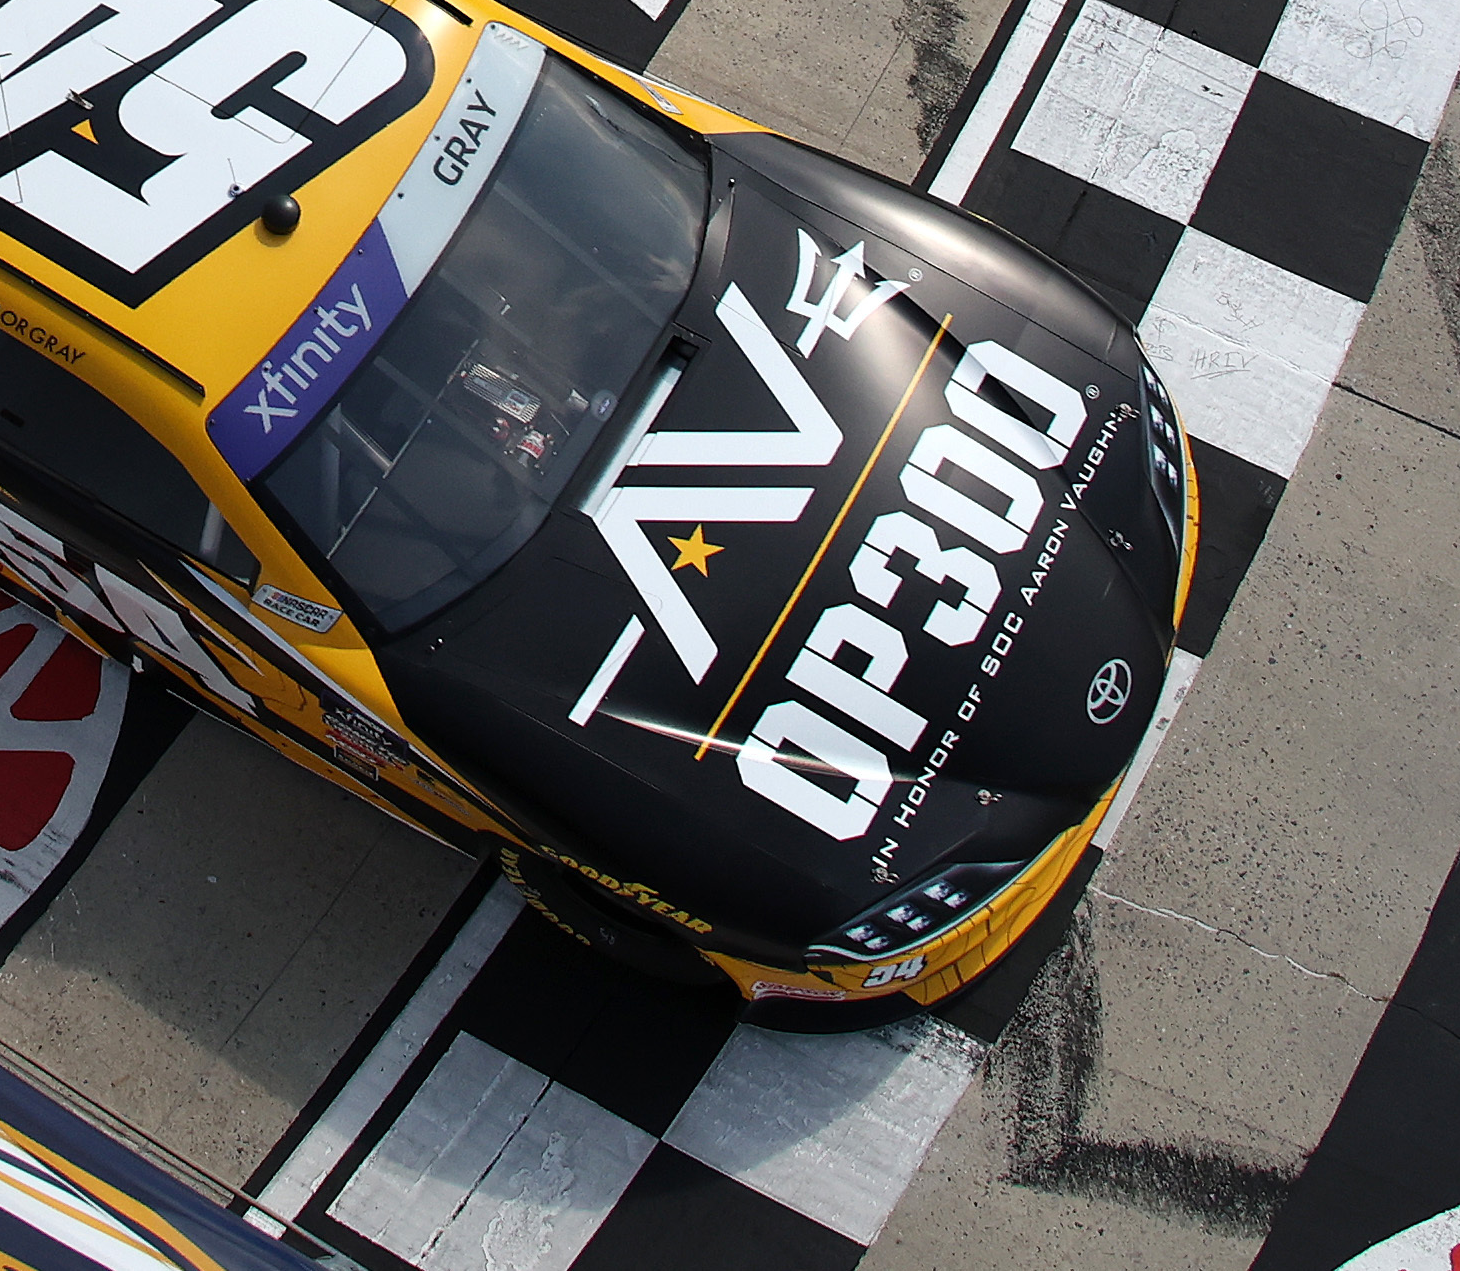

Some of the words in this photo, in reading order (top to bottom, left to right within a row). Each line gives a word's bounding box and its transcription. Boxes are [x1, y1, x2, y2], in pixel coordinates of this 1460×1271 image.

[431, 87, 500, 190] GRAY
[28, 328, 87, 366] GRAY
[241, 279, 378, 436] xfinity
[262, 597, 295, 616] RACE
[296, 610, 321, 628] CAR
[281, 597, 329, 620] NASCAR
[735, 339, 1090, 843] OP300
[871, 832, 898, 871] IN
[894, 727, 961, 828] HONOR
[958, 680, 985, 723] OF
[979, 609, 1026, 680] SOC
[1019, 518, 1071, 606] AARON
[1059, 410, 1124, 512] VAUGHN
[539, 843, 714, 935] GOODYEAR
[862, 953, 929, 988] 54
